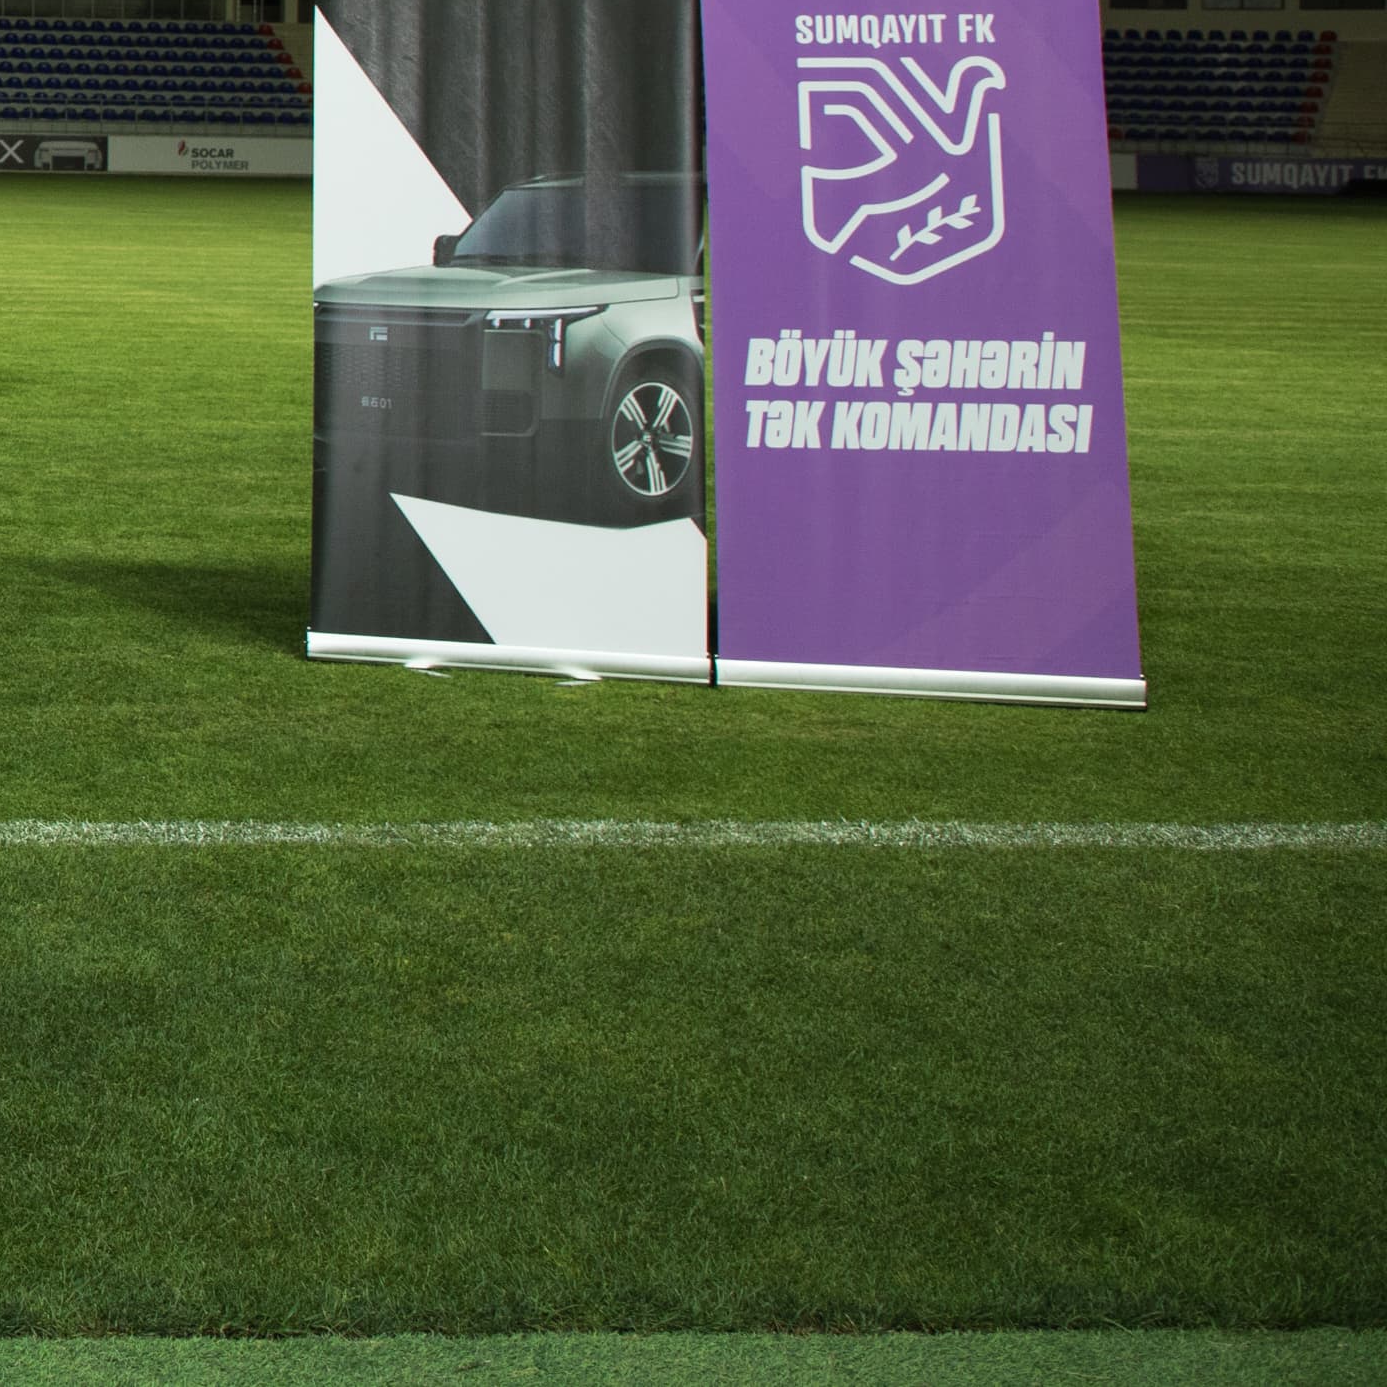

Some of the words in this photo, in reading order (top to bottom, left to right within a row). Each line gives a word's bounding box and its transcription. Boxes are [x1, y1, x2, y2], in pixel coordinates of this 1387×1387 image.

[794, 13, 947, 49] SUMQAYIT
[958, 13, 996, 44] FK
[191, 148, 235, 159] SOCAR
[191, 160, 249, 171] POLYMER
[1232, 162, 1354, 188] SUMQAYIT
[744, 329, 888, 388] BÖYÜK
[745, 400, 826, 450] TƏK
[830, 401, 1094, 454] KOMANDASI
